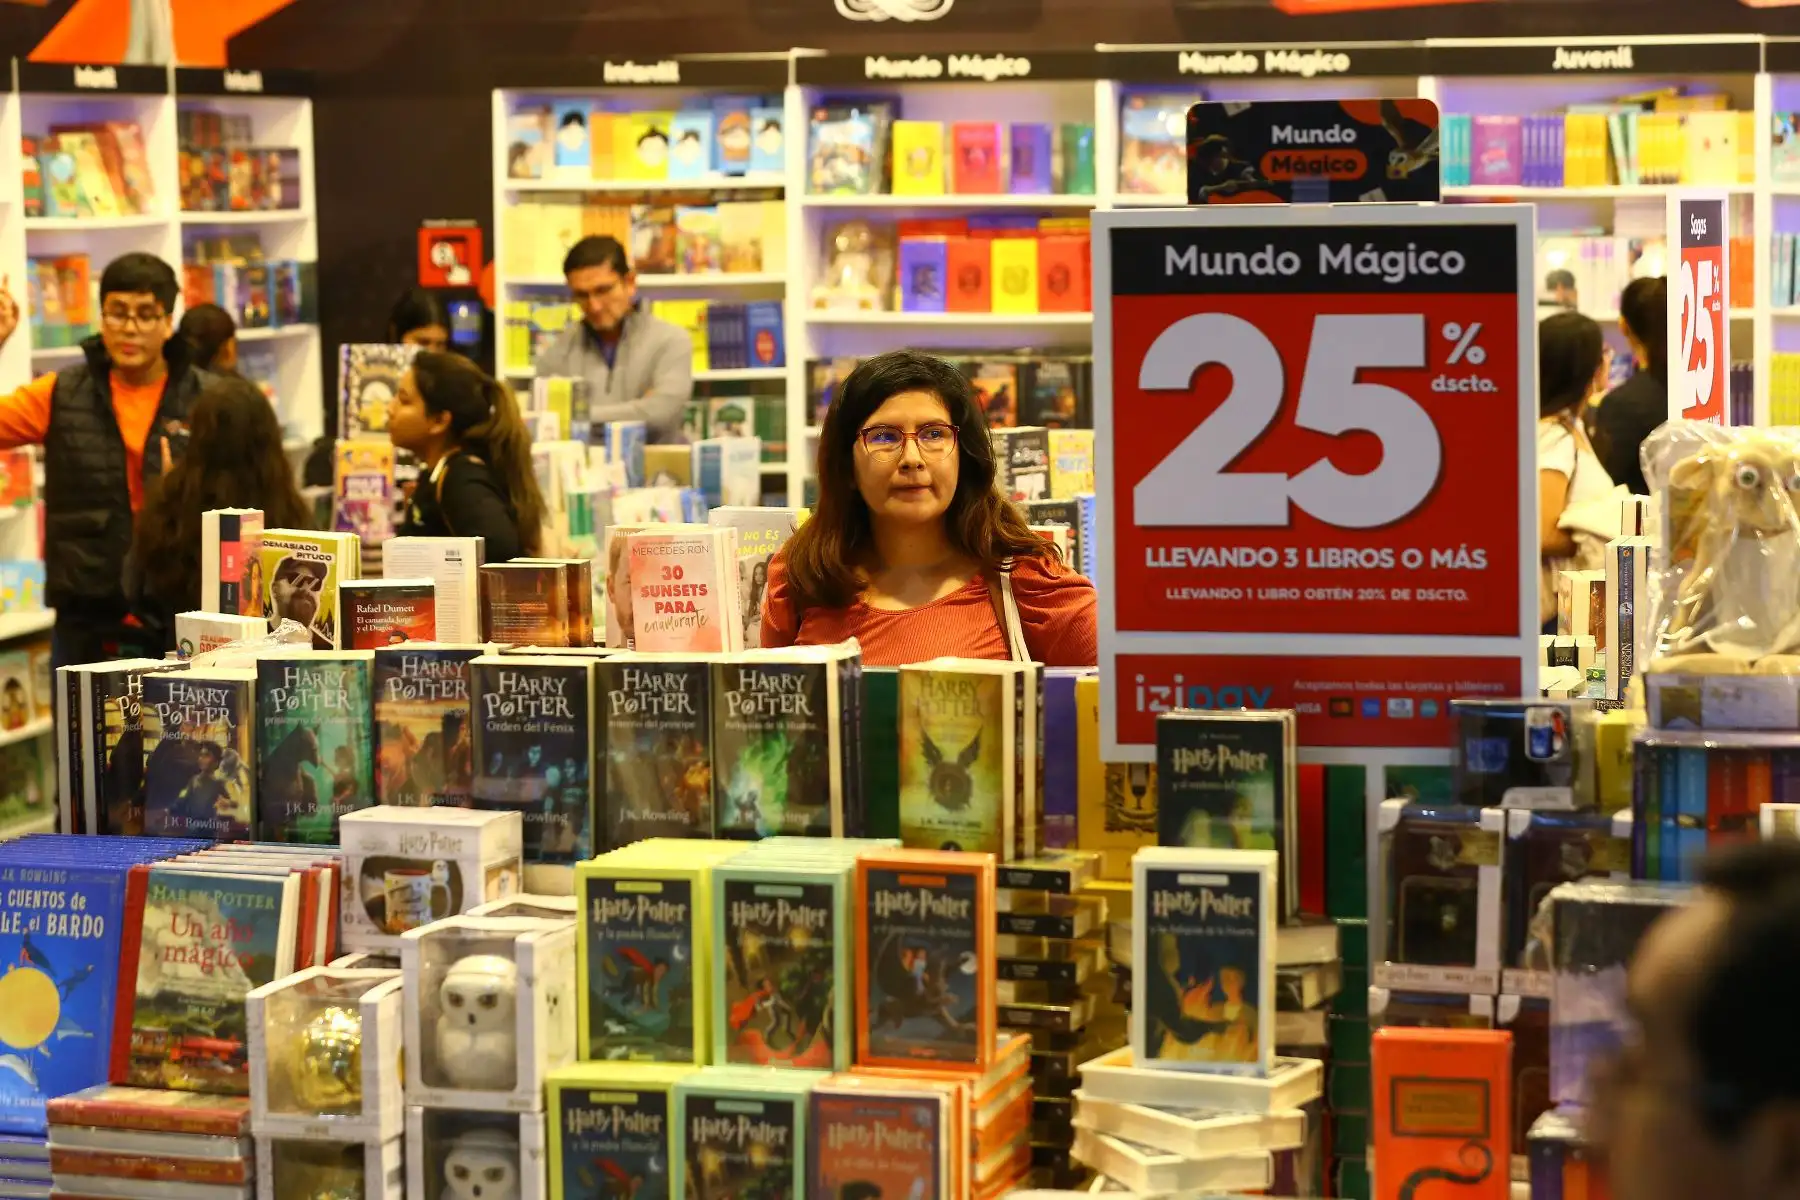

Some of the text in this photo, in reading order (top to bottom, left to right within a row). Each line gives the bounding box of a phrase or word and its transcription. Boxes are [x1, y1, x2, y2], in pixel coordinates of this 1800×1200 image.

[865, 54, 1032, 82] Mundo Mágico
[1179, 49, 1351, 78] Mundo Mágico
[1553, 46, 1634, 71] Juvenil
[1271, 125, 1357, 146] Mundo
[1270, 151, 1358, 178] Mágico
[1690, 213, 1708, 241] Sagas
[1164, 243, 1466, 284] Mundo Mágico
[1713, 264, 1720, 294] %
[1441, 321, 1487, 366] %
[1431, 374, 1499, 393] dscto.
[1134, 312, 1441, 528] 25
[262, 540, 318, 552] DEMASIADO
[743, 529, 781, 541] NO ES
[296, 552, 333, 562] PITUCO
[632, 545, 709, 557] MERCEDES RON
[1145, 543, 1488, 570] LLEVANDO 3 LIBROS O MÁS
[661, 564, 684, 580] 30
[640, 583, 708, 598] SUNSETS
[1166, 585, 1469, 601] LLEVANDO 1 LIBRO OBTÉN 20% DE DSCTO.
[356, 604, 415, 613] Rafael Dumett
[357, 616, 364, 624] El
[365, 615, 395, 624] camarada
[654, 600, 696, 614] PARA
[362, 624, 368, 632] el
[369, 624, 393, 633] Dragón
[644, 608, 709, 634] enamorarte
[283, 667, 347, 690] HARRY
[402, 655, 465, 678] HARRY
[387, 677, 470, 702] POTTER
[498, 671, 567, 695] HARRY
[621, 668, 688, 692] HARRY
[738, 668, 807, 693] HARRY
[920, 675, 981, 698] HARRY
[1135, 673, 1273, 711] izipay
[1294, 679, 1353, 692] Aceptamos
[168, 682, 230, 707] HARRY
[270, 687, 355, 713] POTTER
[483, 692, 575, 719] POTTER
[607, 689, 696, 716] POTTER
[724, 691, 815, 718] POTTER
[155, 701, 236, 729] POTTER
[1295, 702, 1322, 713] VISA
[486, 720, 576, 734] Orden del Fénix
[1172, 744, 1268, 777] Harry Potter
[308, 802, 354, 815] Rowling
[641, 808, 690, 823] Rowling
[164, 817, 230, 831] J.K. Rowling
[400, 830, 430, 855] Harry
[21, 868, 67, 884] ROWLING
[8, 888, 87, 911] CUENTOS de
[213, 889, 275, 910] POTTER
[593, 894, 688, 928] Harry Potter
[873, 888, 970, 921] Harry Potter
[1152, 888, 1255, 922] Harry Potter
[29, 915, 41, 932] el
[46, 911, 105, 940] BARDO
[731, 898, 828, 932] Harry Potter
[171, 912, 255, 944] Un año
[163, 943, 255, 977] mágico
[567, 1105, 663, 1140] Harry Potter
[692, 1114, 789, 1149] Harry Potter
[828, 1120, 926, 1153] Harry Potter
